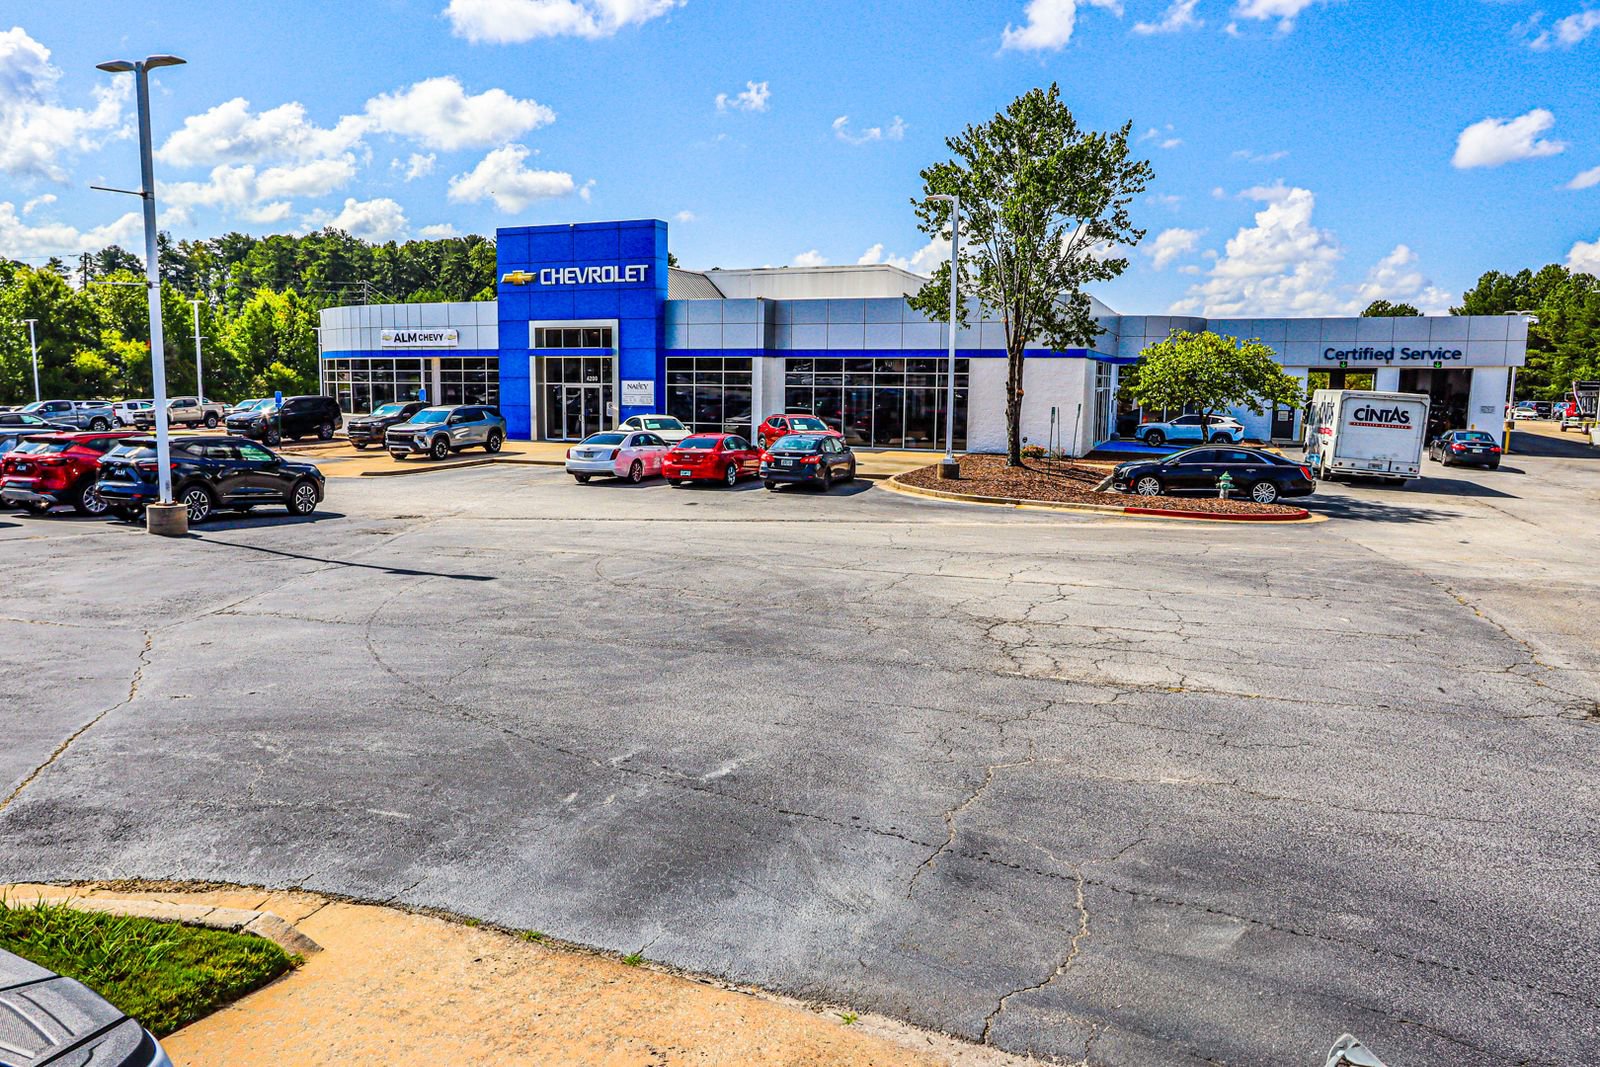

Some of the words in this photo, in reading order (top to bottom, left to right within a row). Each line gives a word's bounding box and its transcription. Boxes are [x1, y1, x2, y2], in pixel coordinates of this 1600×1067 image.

[540, 265, 648, 285] CHEVROLET
[394, 333, 417, 343] ALM
[418, 333, 444, 342] CHEVY
[1324, 347, 1394, 360] Certified
[1400, 347, 1462, 360] Service
